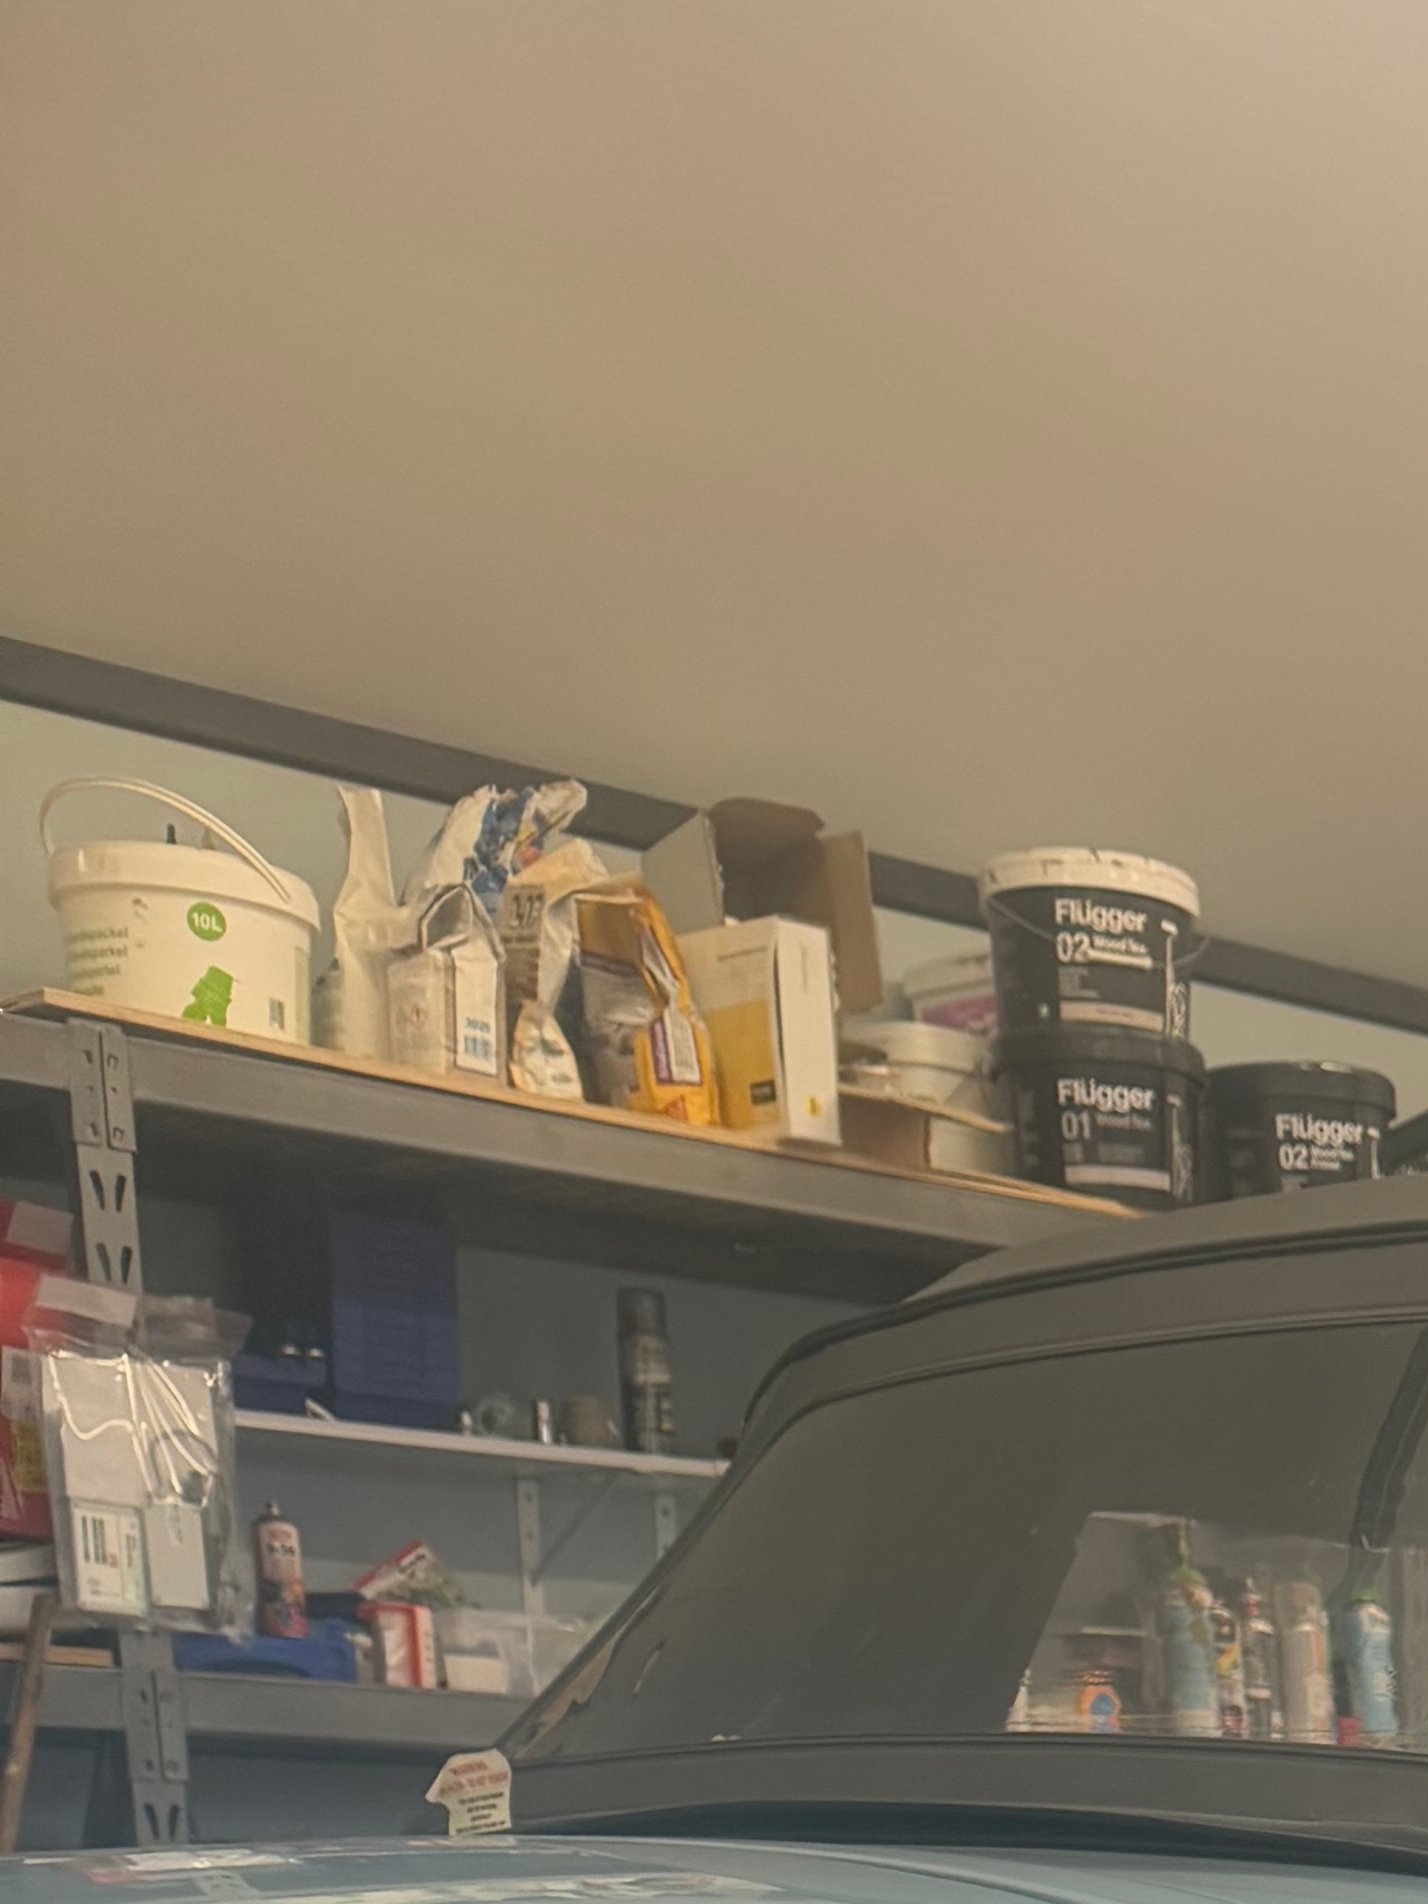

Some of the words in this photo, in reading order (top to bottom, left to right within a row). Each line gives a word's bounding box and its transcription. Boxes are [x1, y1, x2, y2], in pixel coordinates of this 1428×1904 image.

[191, 912, 223, 933] 10L
[1055, 898, 1147, 935] Flügger
[1056, 931, 1091, 963] 02
[1057, 1077, 1154, 1114] Flügger
[1061, 1109, 1091, 1141] 01
[1275, 1113, 1363, 1150] Flügger
[1279, 1143, 1308, 1171] 02
